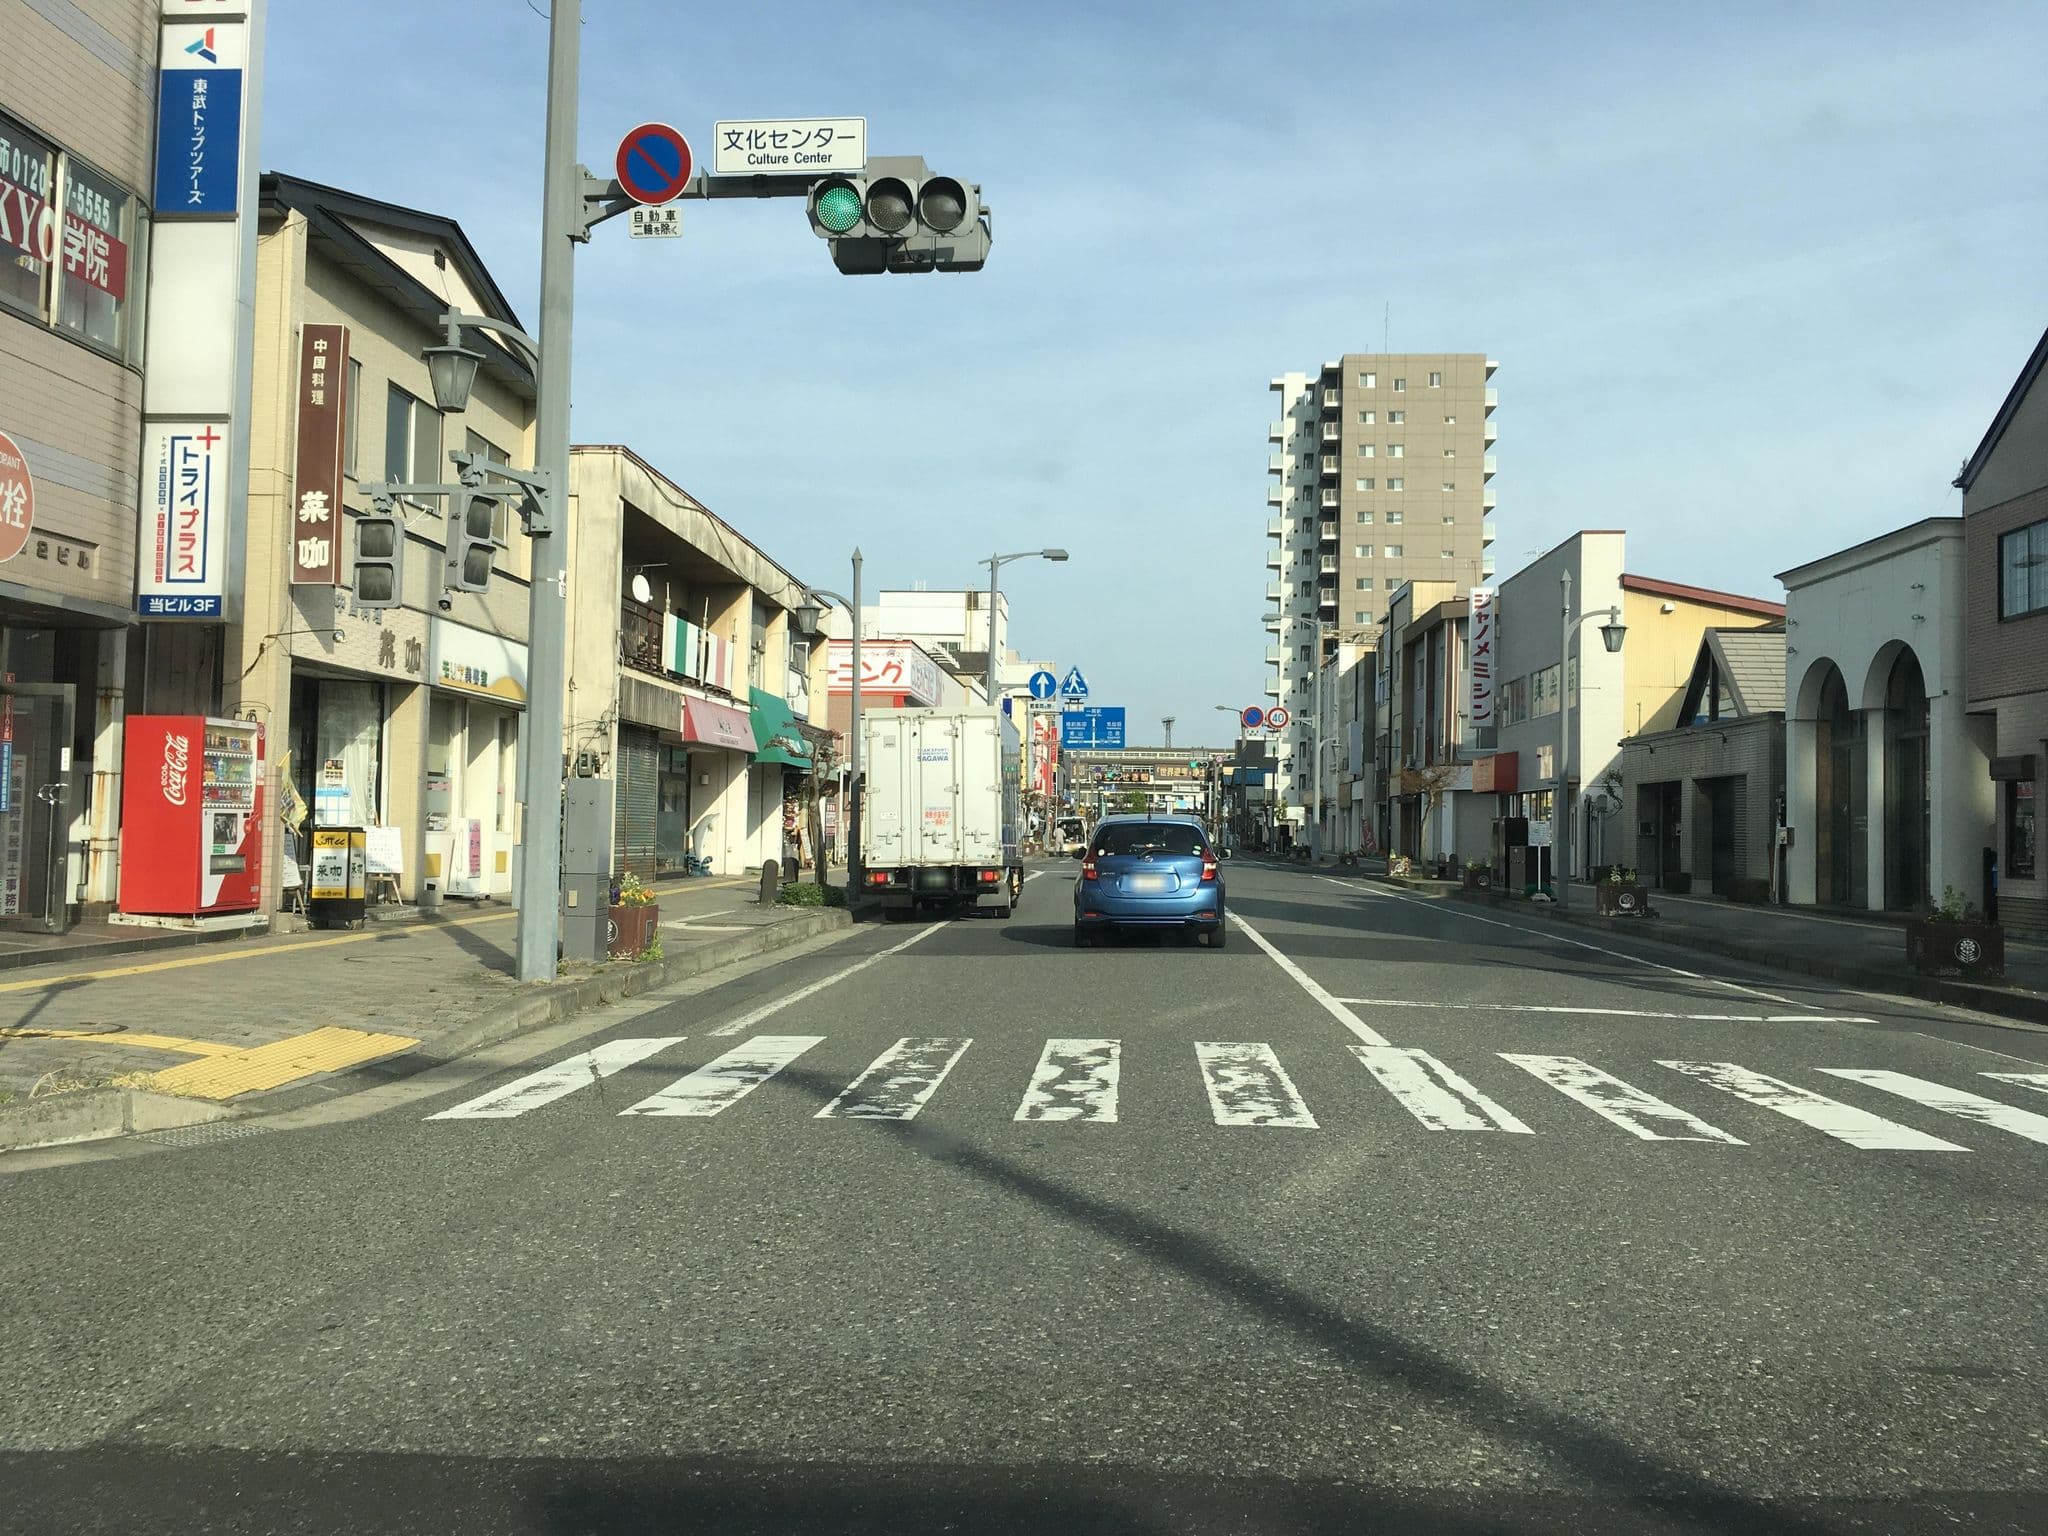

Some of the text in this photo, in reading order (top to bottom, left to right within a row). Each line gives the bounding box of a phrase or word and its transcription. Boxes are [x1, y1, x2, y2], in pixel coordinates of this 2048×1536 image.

[187, 79, 208, 204] 東武トップツアーズ
[723, 127, 856, 152] 文化センター
[747, 151, 833, 165] Culture Center
[634, 209, 677, 222] 自動車
[633, 223, 678, 236] 二輪を除く
[311, 338, 328, 405] 中国料理
[178, 445, 200, 573] トライプラス
[149, 597, 215, 614] 当ビル3F
[1473, 593, 1491, 721] ジャノメミシン
[1272, 713, 1285, 723] 40
